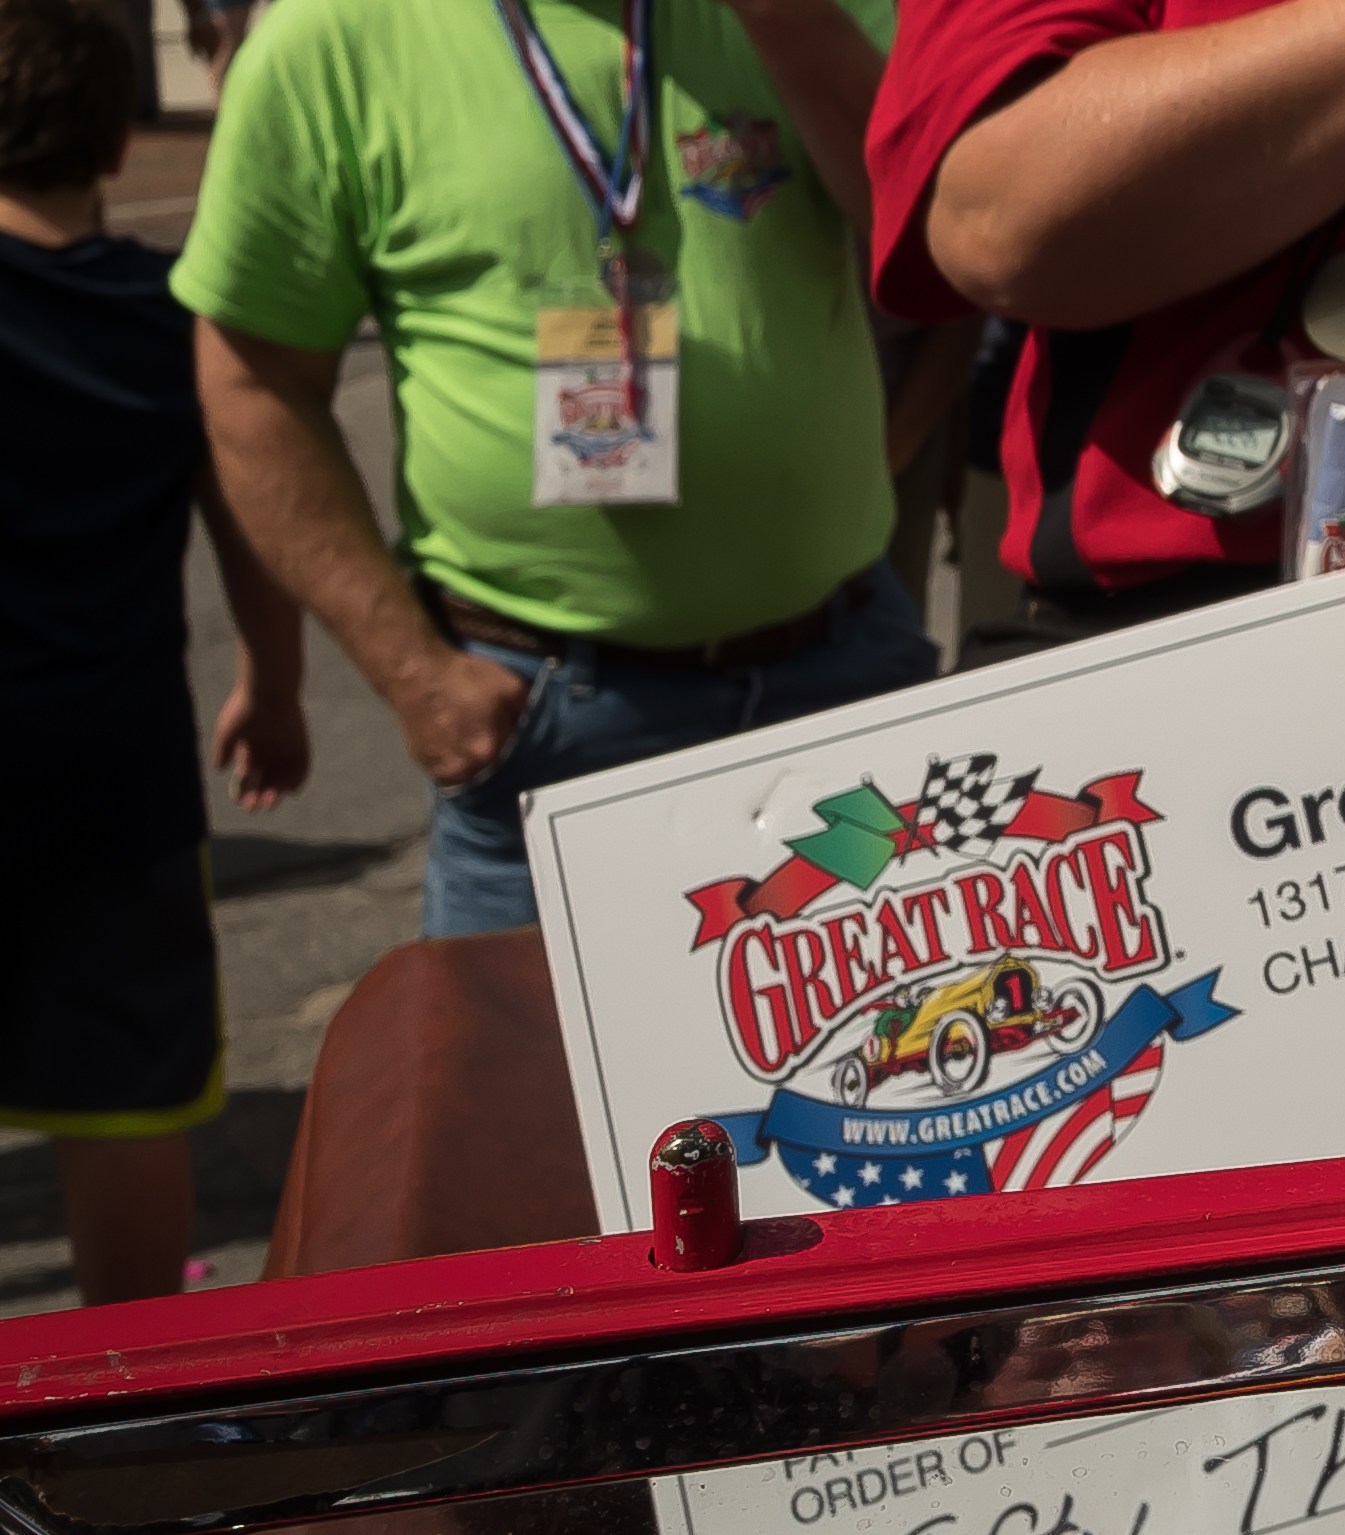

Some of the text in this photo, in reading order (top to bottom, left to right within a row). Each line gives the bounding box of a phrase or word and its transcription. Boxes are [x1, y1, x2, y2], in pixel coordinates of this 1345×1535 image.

[729, 832, 1155, 1070] GREAT RACE
[842, 1049, 1108, 1145] WWW.GREATRACE.COM
[790, 1449, 947, 1524] ORDER
[959, 1429, 1018, 1474] OF
